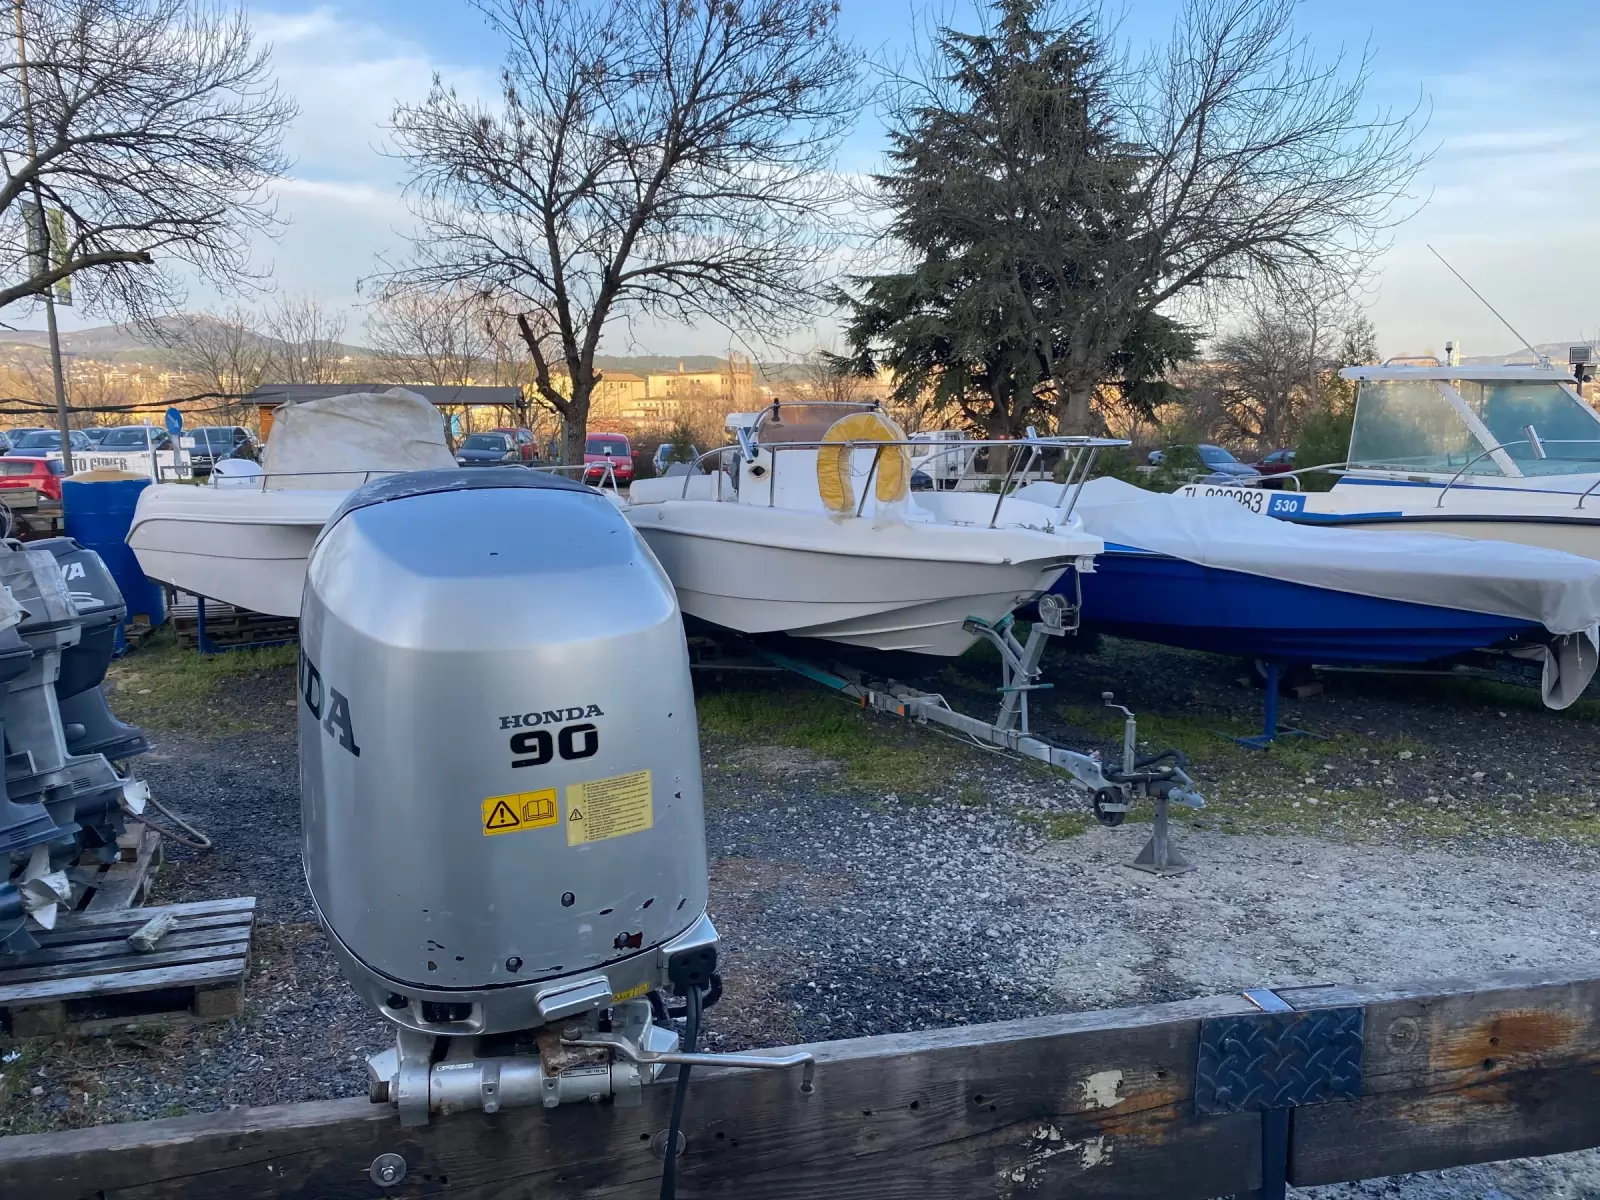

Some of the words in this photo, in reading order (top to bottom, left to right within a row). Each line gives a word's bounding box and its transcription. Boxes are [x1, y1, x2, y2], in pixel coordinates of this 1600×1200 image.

[1273, 499, 1299, 513] 530
[61, 562, 86, 581] VA
[499, 704, 604, 729] HONDA
[510, 723, 599, 769] 90
